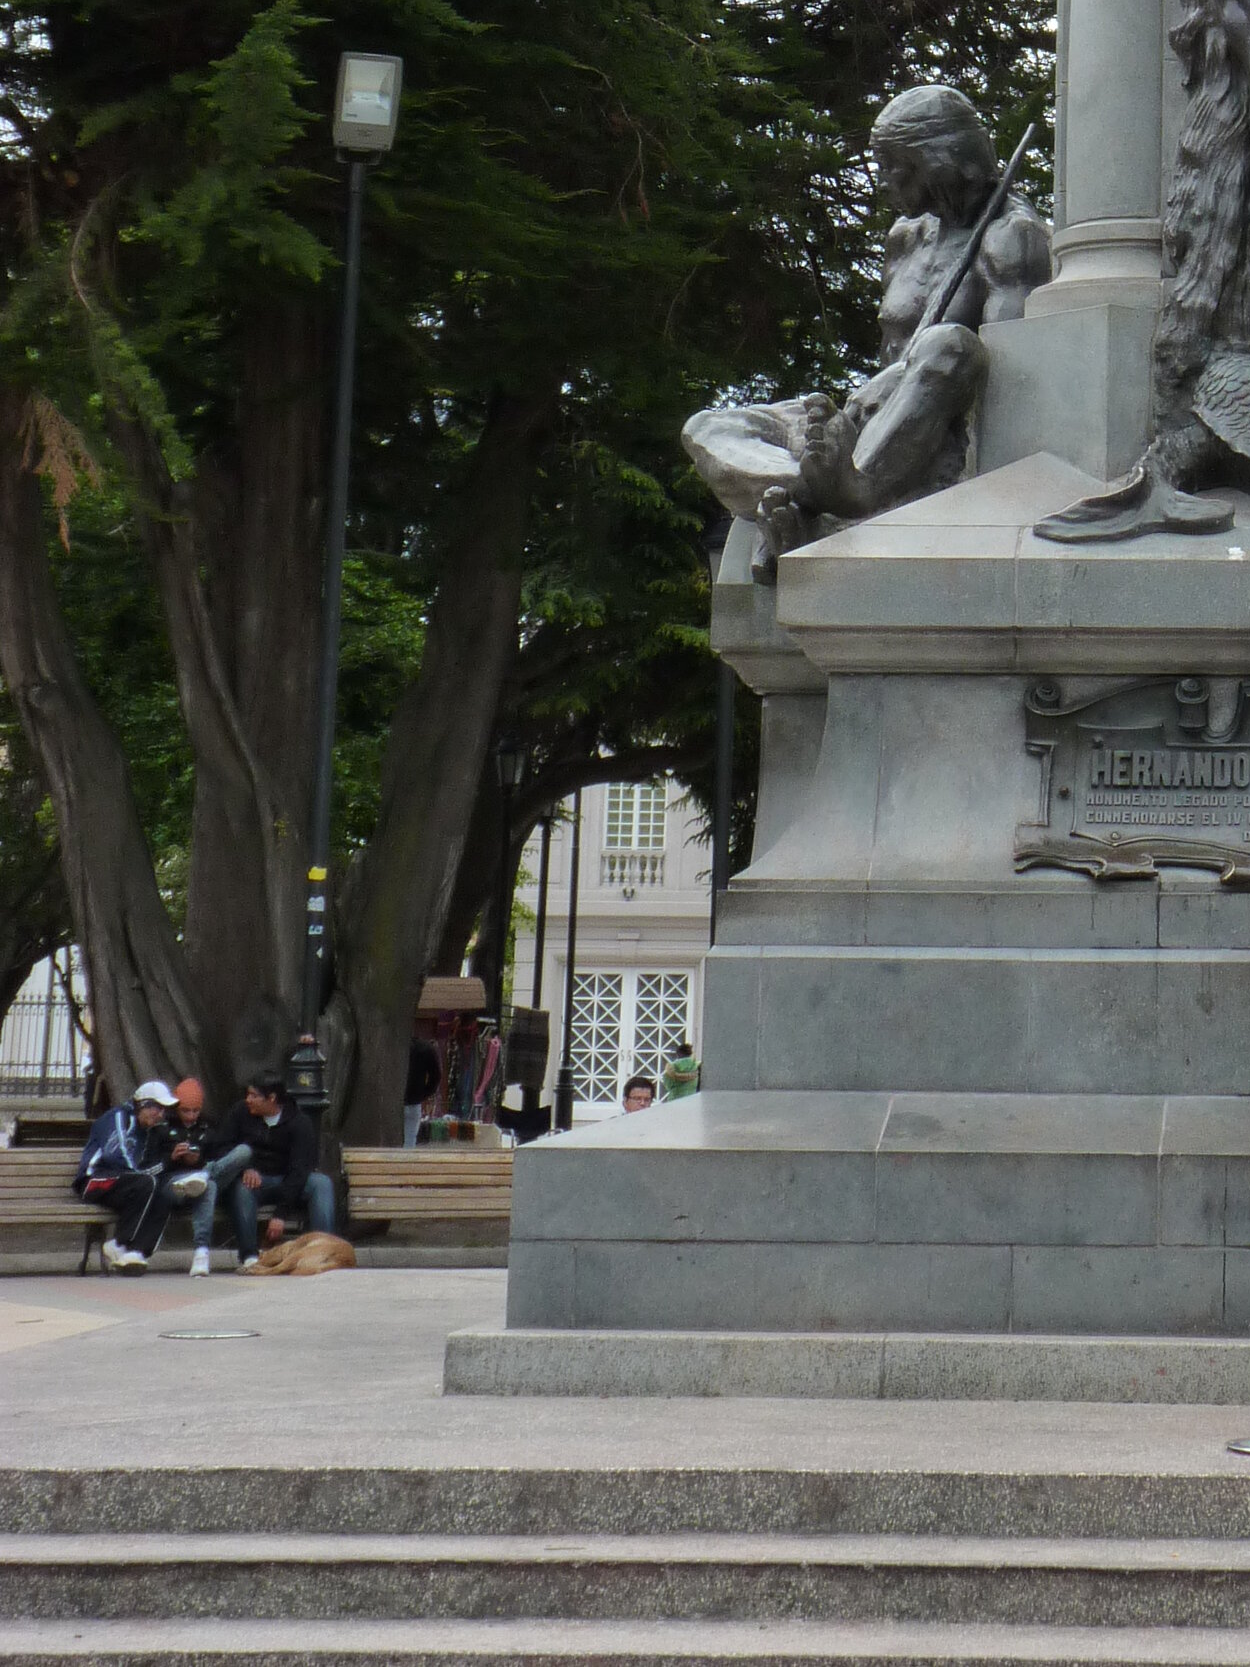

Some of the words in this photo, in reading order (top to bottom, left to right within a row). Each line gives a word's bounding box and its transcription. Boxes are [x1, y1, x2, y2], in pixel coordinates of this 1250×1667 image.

[1091, 749, 1250, 790] HERNANDO
[1086, 792, 1168, 807] MONUMENTO
[1173, 794, 1229, 808] LEGADO
[1086, 810, 1195, 825] CONMEMORARSE
[1203, 812, 1220, 826] EL
[1226, 812, 1242, 826] IV
